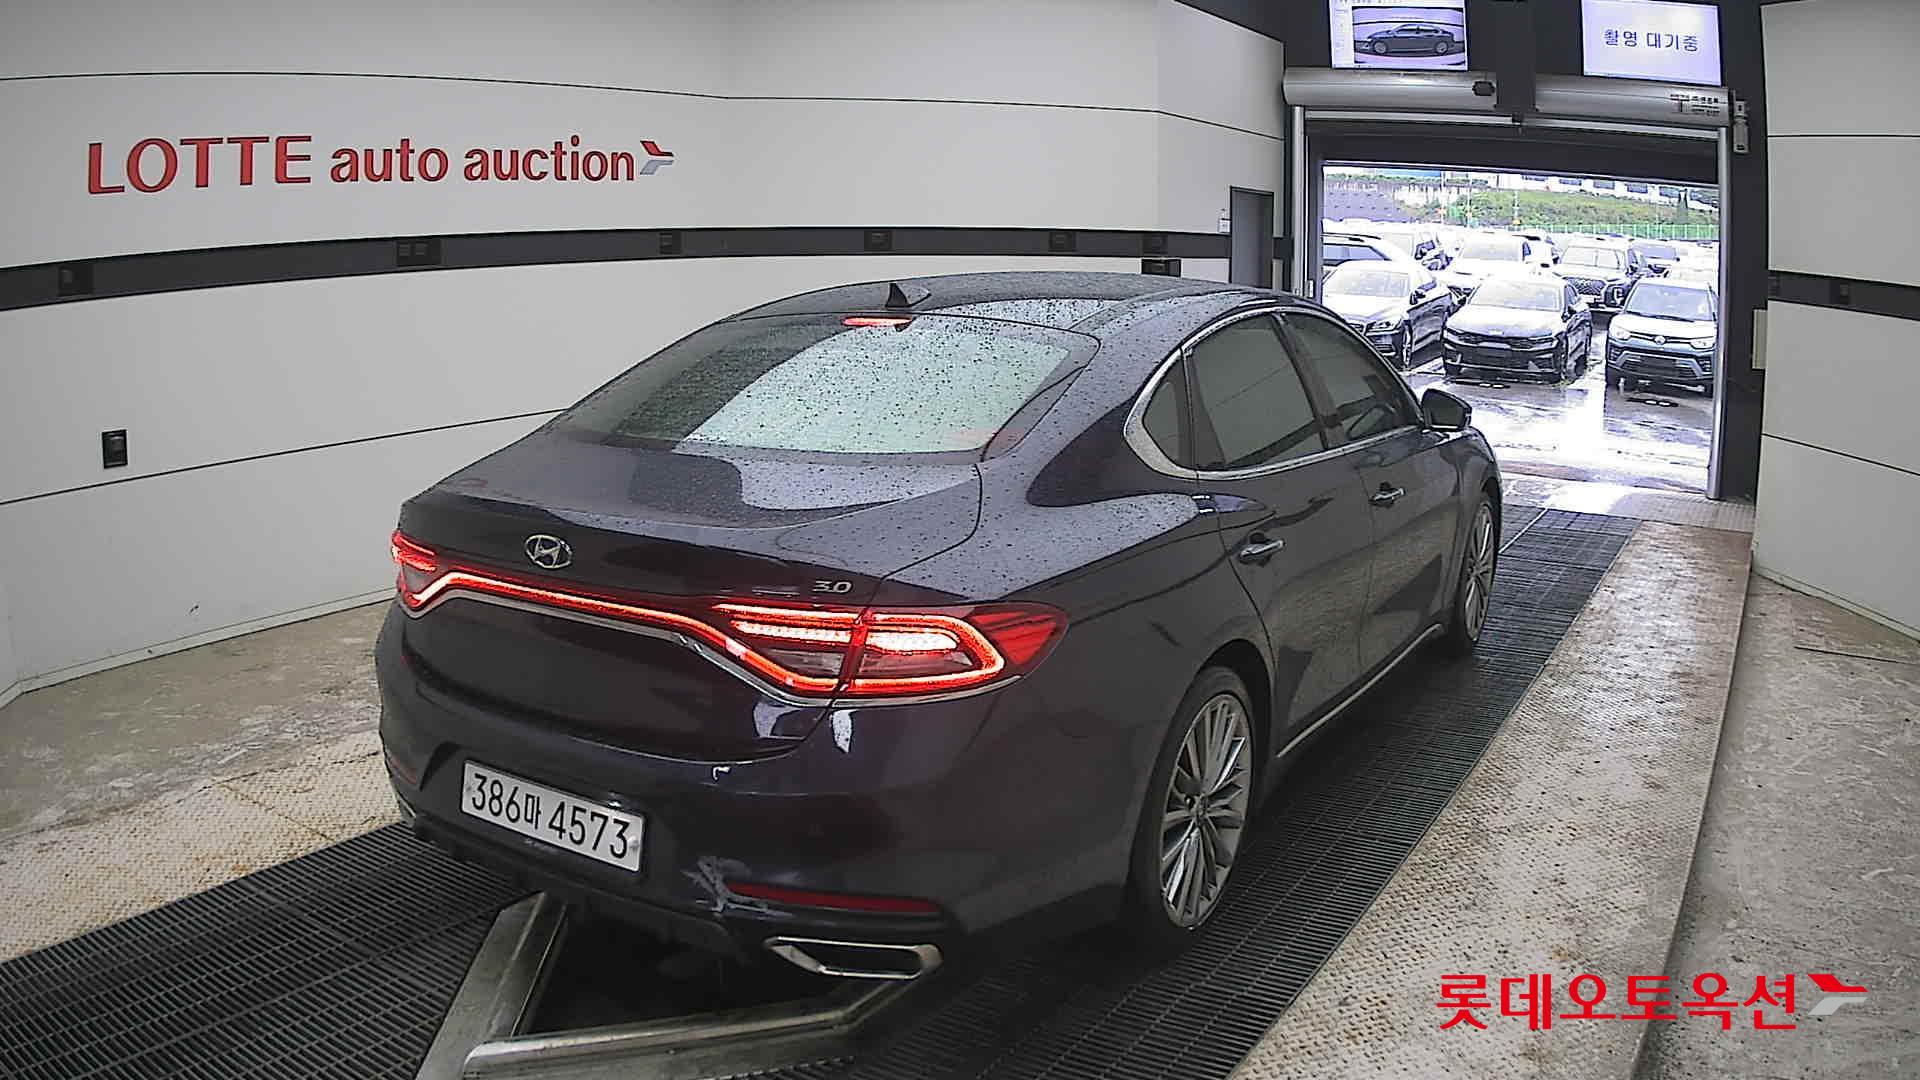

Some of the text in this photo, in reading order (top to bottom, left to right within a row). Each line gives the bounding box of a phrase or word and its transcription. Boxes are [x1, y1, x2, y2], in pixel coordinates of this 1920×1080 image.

[1646, 32, 1699, 52] 대기중
[87, 135, 635, 195] LOTTE auto auction
[472, 772, 631, 859] 386마 4573
